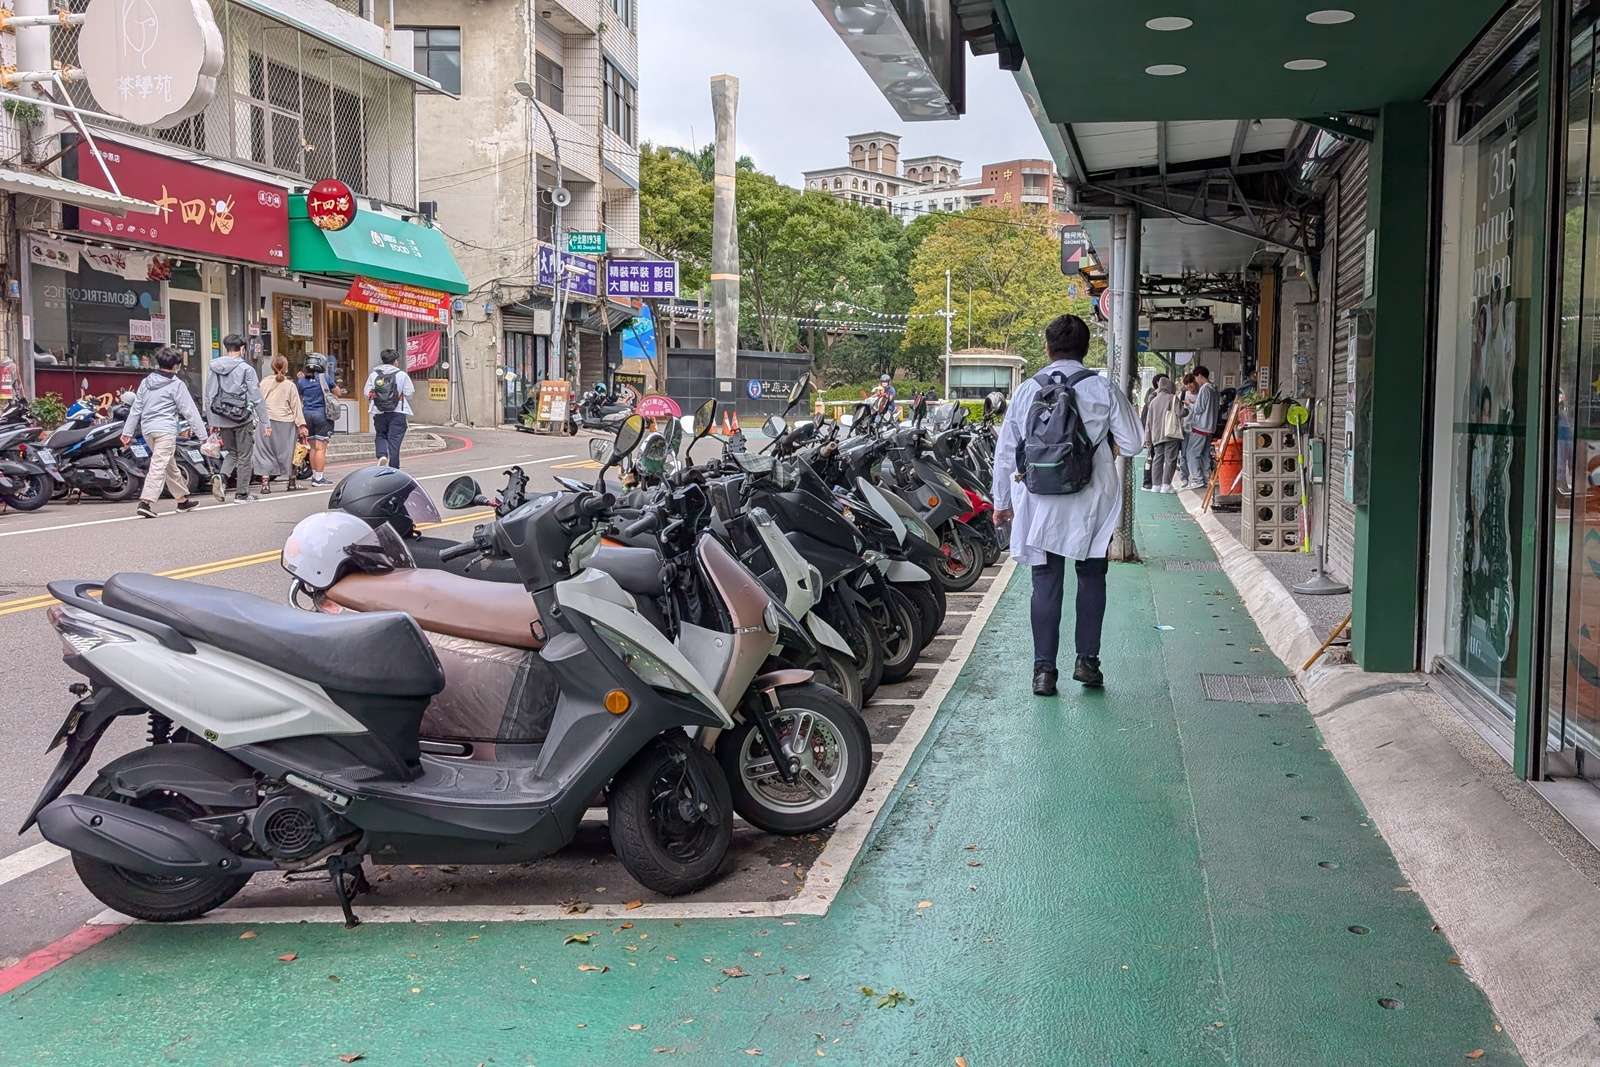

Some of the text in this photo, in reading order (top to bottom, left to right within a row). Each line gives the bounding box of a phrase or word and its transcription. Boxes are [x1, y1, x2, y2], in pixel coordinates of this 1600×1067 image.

[1489, 139, 1517, 200] 315
[609, 266, 649, 278] 精裝平裝
[654, 266, 673, 278] 影印
[609, 280, 649, 292] 大圖輸出
